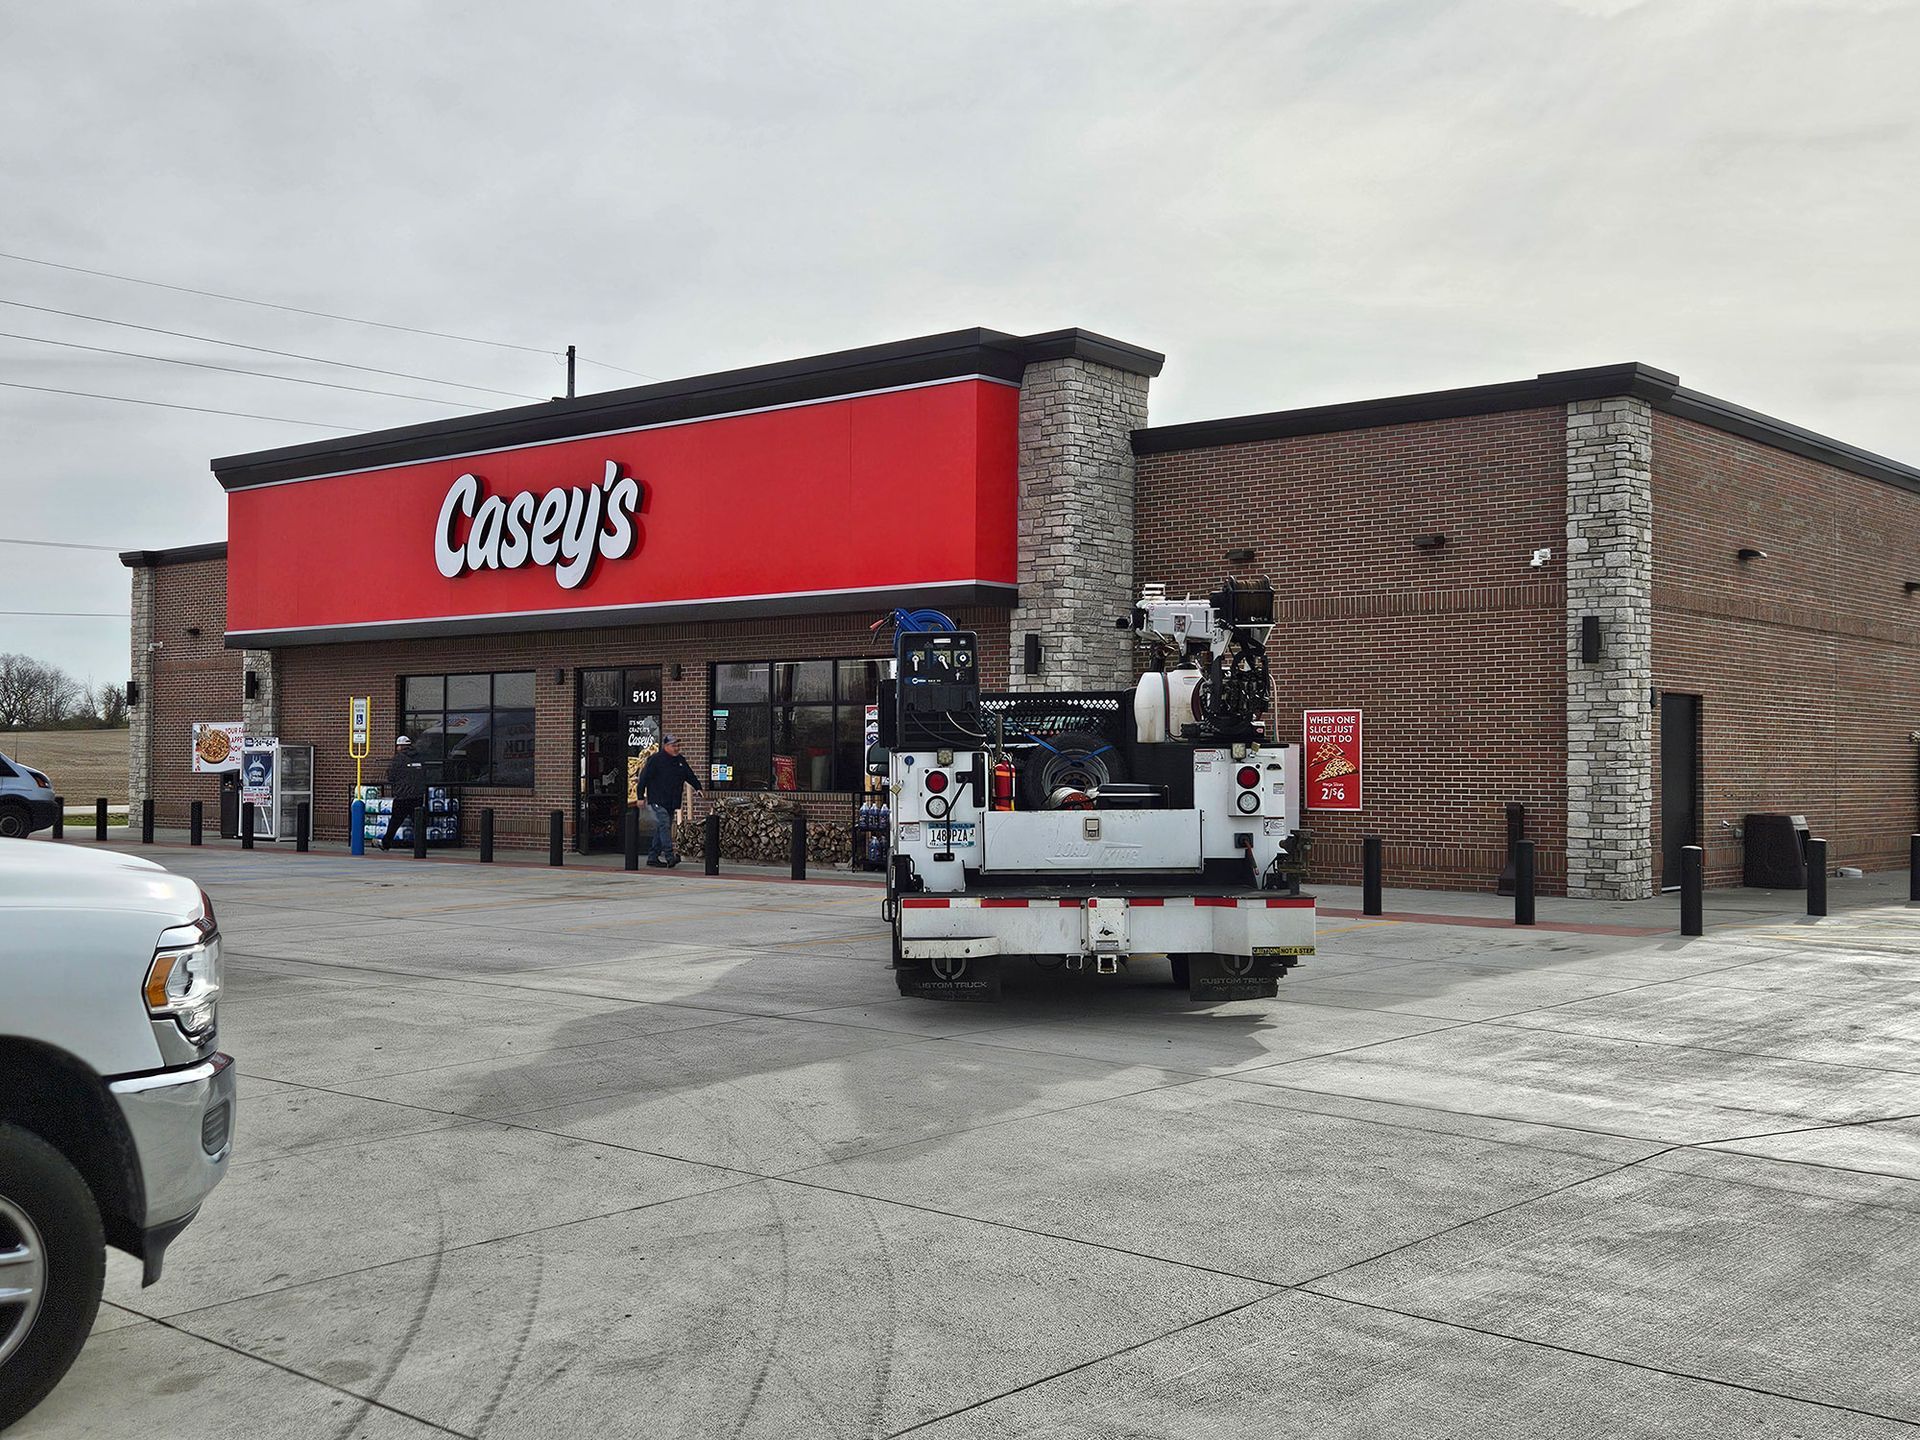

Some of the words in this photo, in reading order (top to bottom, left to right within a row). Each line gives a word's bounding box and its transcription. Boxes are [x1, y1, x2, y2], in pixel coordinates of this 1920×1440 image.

[434, 459, 639, 589] Casey's
[633, 690, 657, 702] 5113
[1309, 716, 1335, 724] WHEN
[1336, 716, 1356, 724] ONE
[1309, 725, 1332, 734] SLICE
[1333, 725, 1354, 734] JUST
[628, 733, 654, 749] Casey's
[1309, 735, 1337, 743] WON'T
[1338, 735, 1352, 743] DO
[1321, 787, 1345, 800] 2/$6
[932, 829, 968, 842] 148PZA
